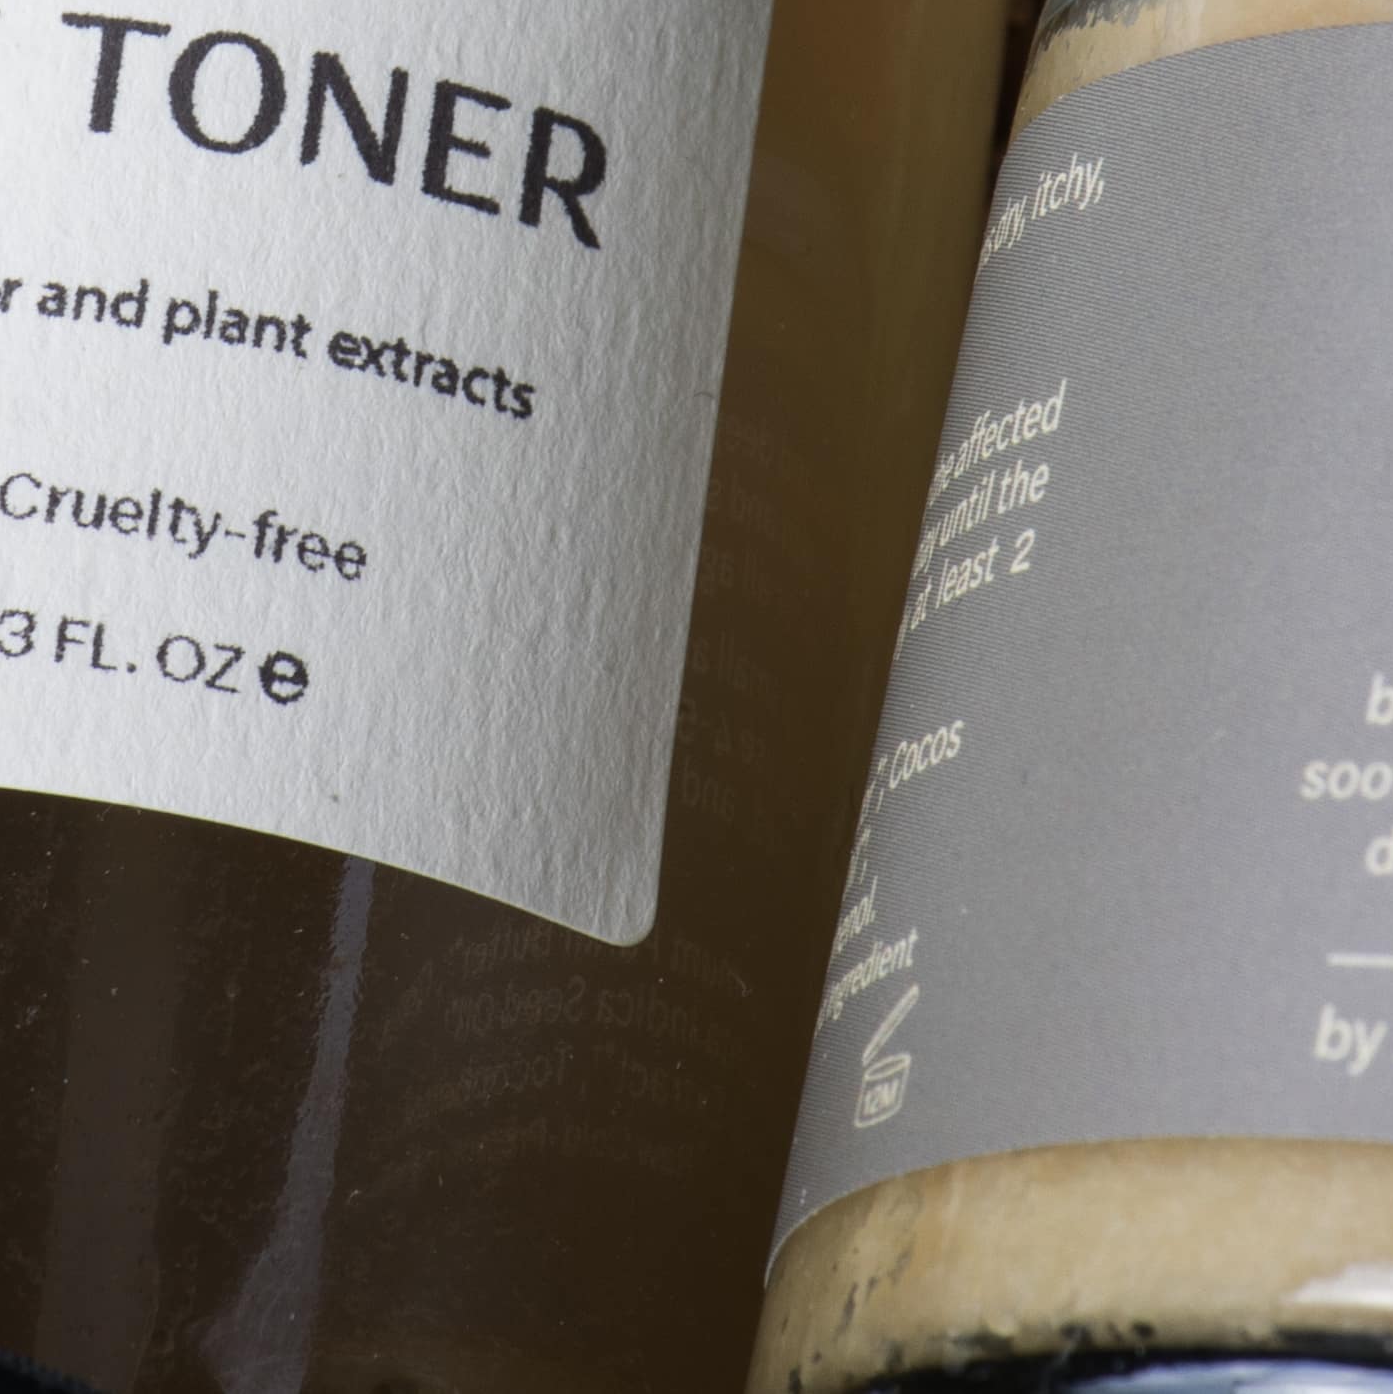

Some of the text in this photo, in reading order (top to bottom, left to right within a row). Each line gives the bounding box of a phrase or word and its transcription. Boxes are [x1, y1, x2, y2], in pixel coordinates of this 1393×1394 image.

[60, 10, 608, 250] TONER
[1031, 151, 1106, 223] itchy,
[36, 279, 150, 332] and
[160, 292, 313, 360] plant
[326, 327, 538, 421] extracts
[953, 376, 1069, 481] affected
[937, 458, 1051, 549] until the
[934, 536, 1002, 611] least
[1008, 526, 1037, 576] 2
[53, 615, 139, 675] FL.
[887, 719, 965, 791] Cocos
[1312, 1005, 1379, 1078] by
